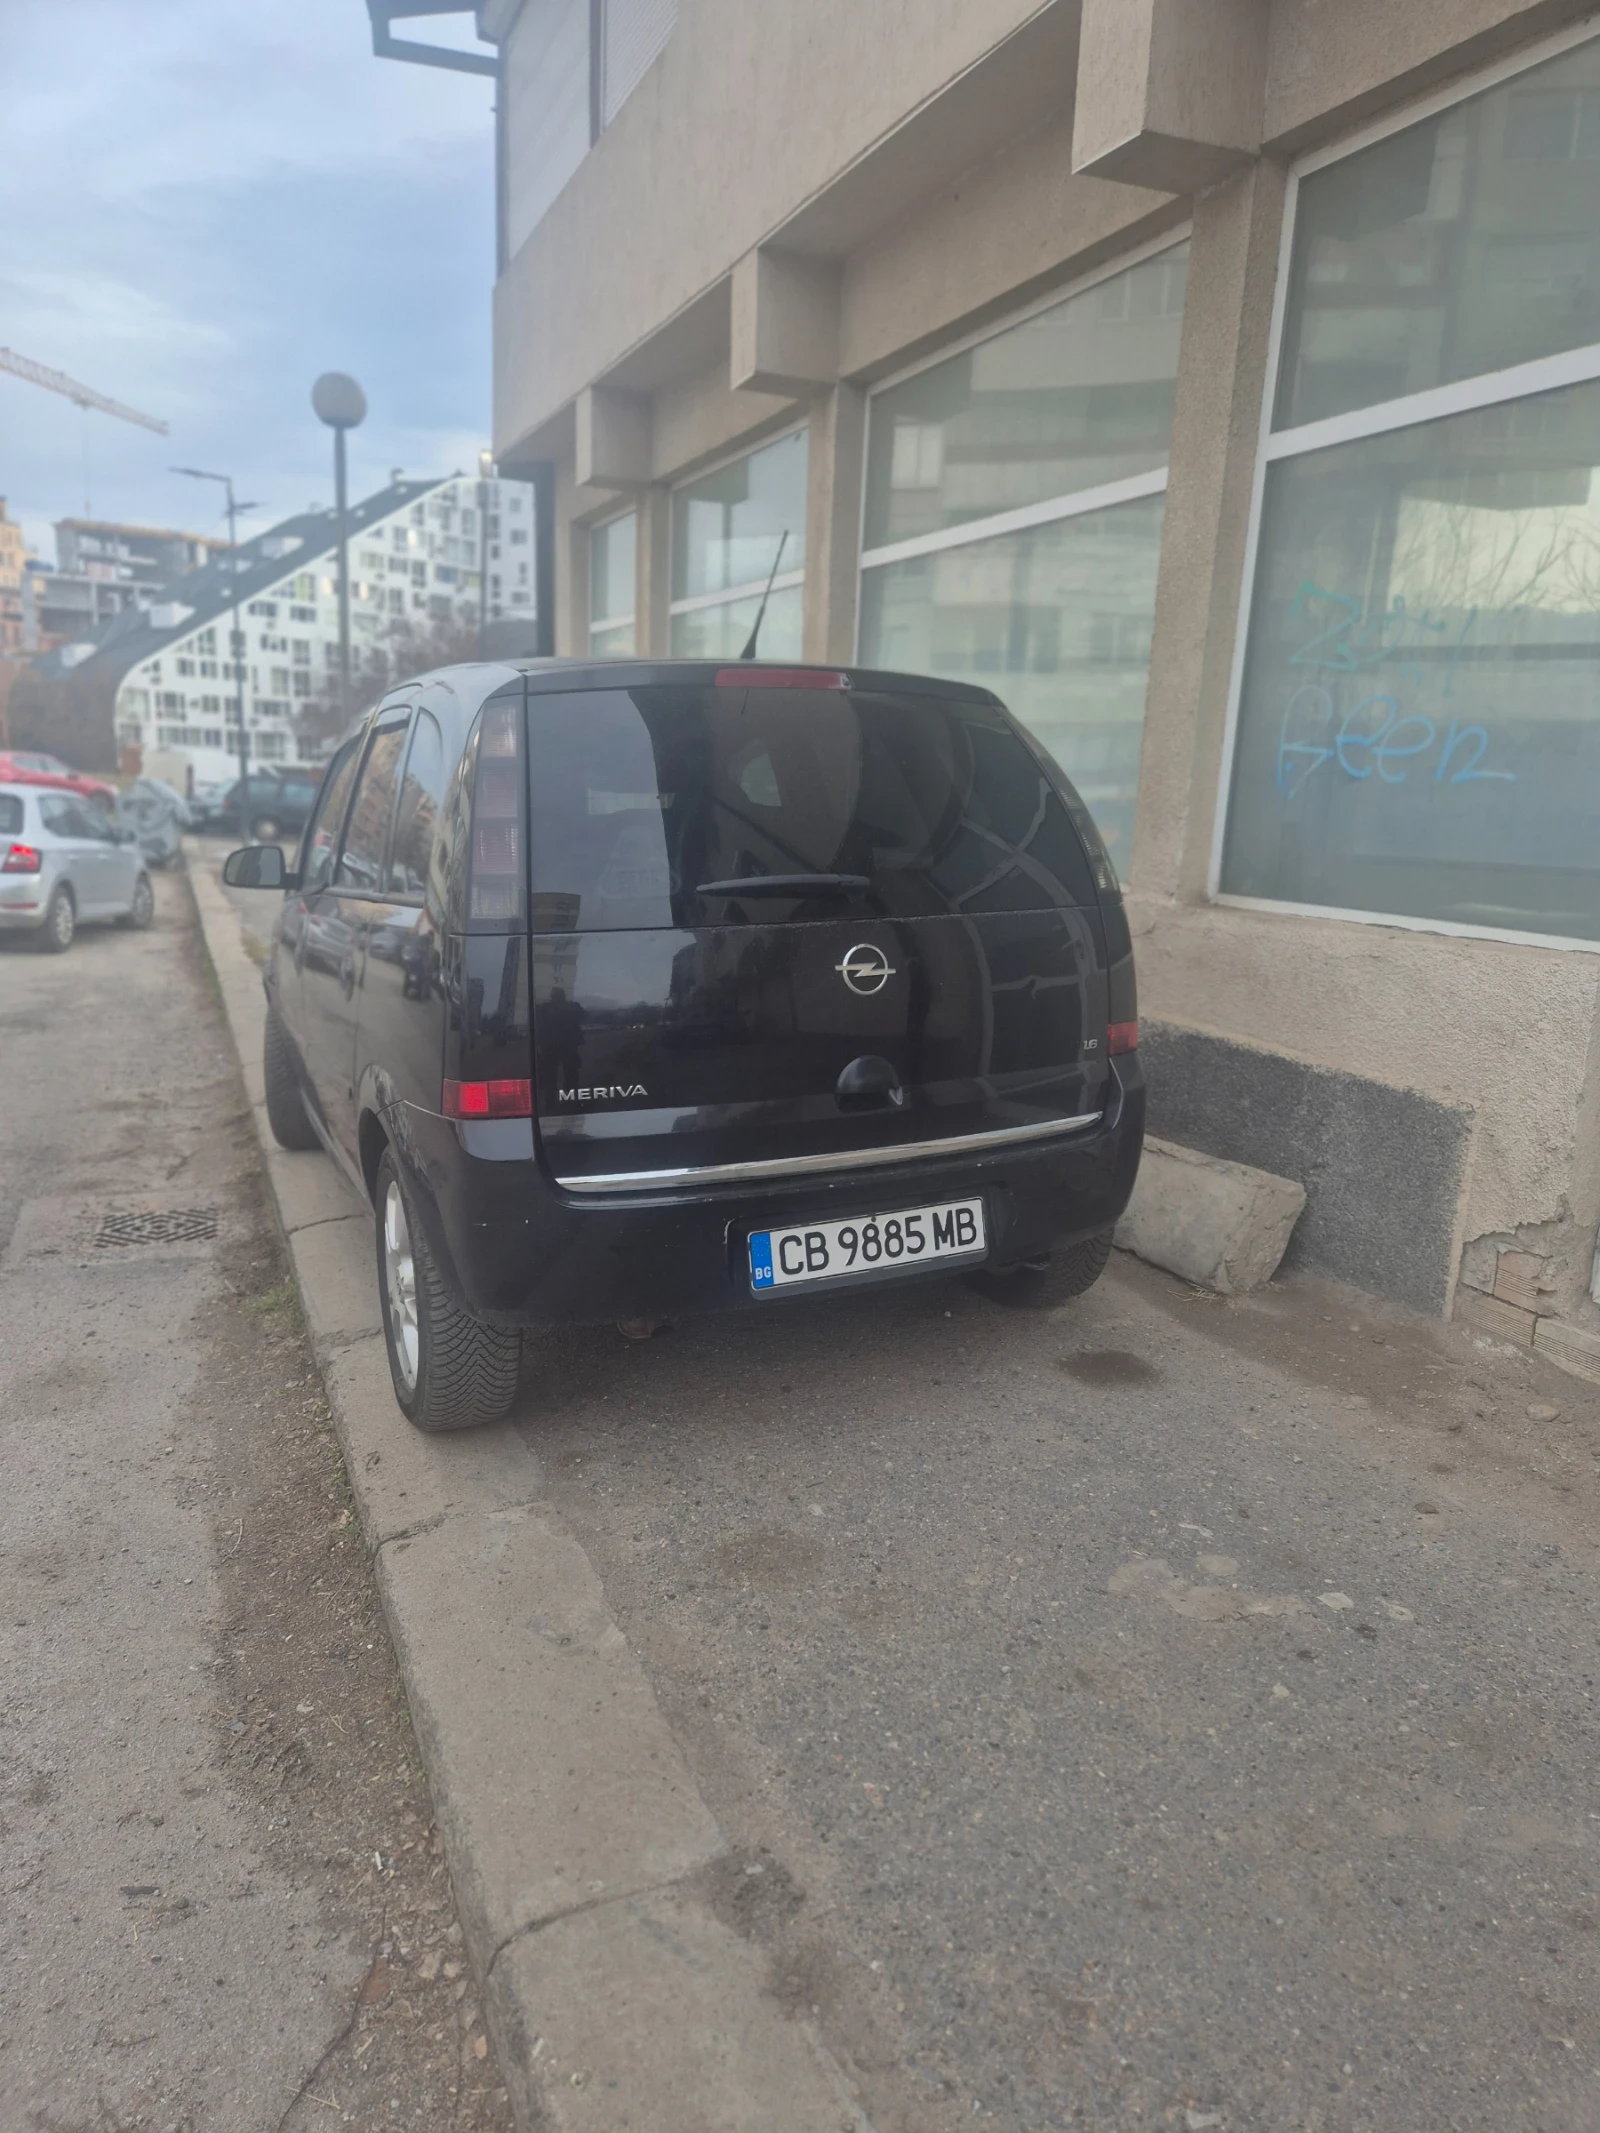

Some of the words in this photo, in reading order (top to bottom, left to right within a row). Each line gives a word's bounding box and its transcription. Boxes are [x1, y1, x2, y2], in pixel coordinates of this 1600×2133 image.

[559, 1084, 648, 1101] MERIVA
[779, 1231, 830, 1275] CB
[837, 1215, 926, 1267] 9885
[932, 1207, 977, 1250] MB
[755, 1266, 772, 1280] BG
